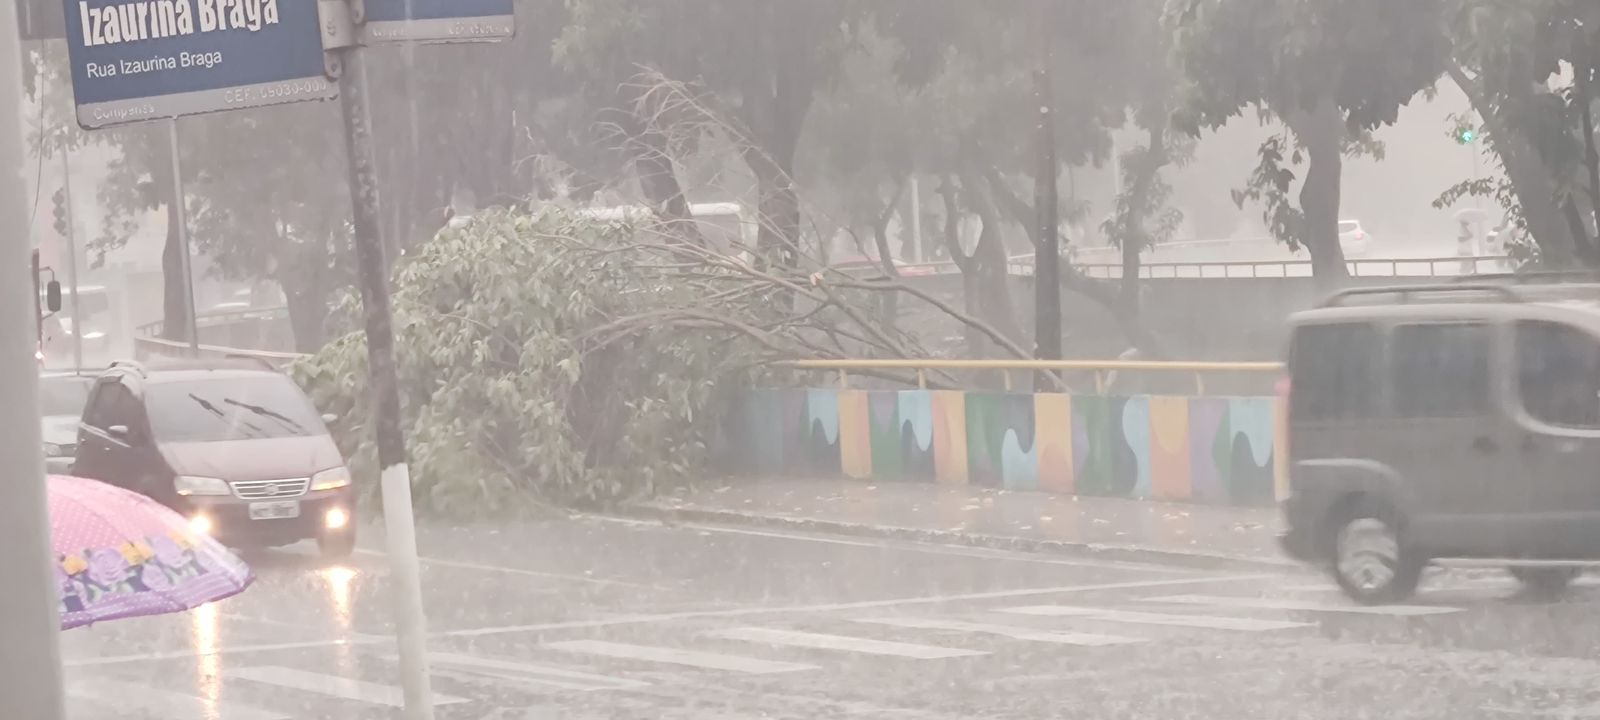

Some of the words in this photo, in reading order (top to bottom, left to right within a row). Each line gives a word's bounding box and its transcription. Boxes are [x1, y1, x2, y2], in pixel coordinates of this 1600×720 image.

[80, 1, 194, 46] Izaurina
[199, 0, 279, 31] Braga
[86, 63, 117, 79] Rua
[120, 55, 177, 74] Izaurina
[180, 51, 223, 69] Braga
